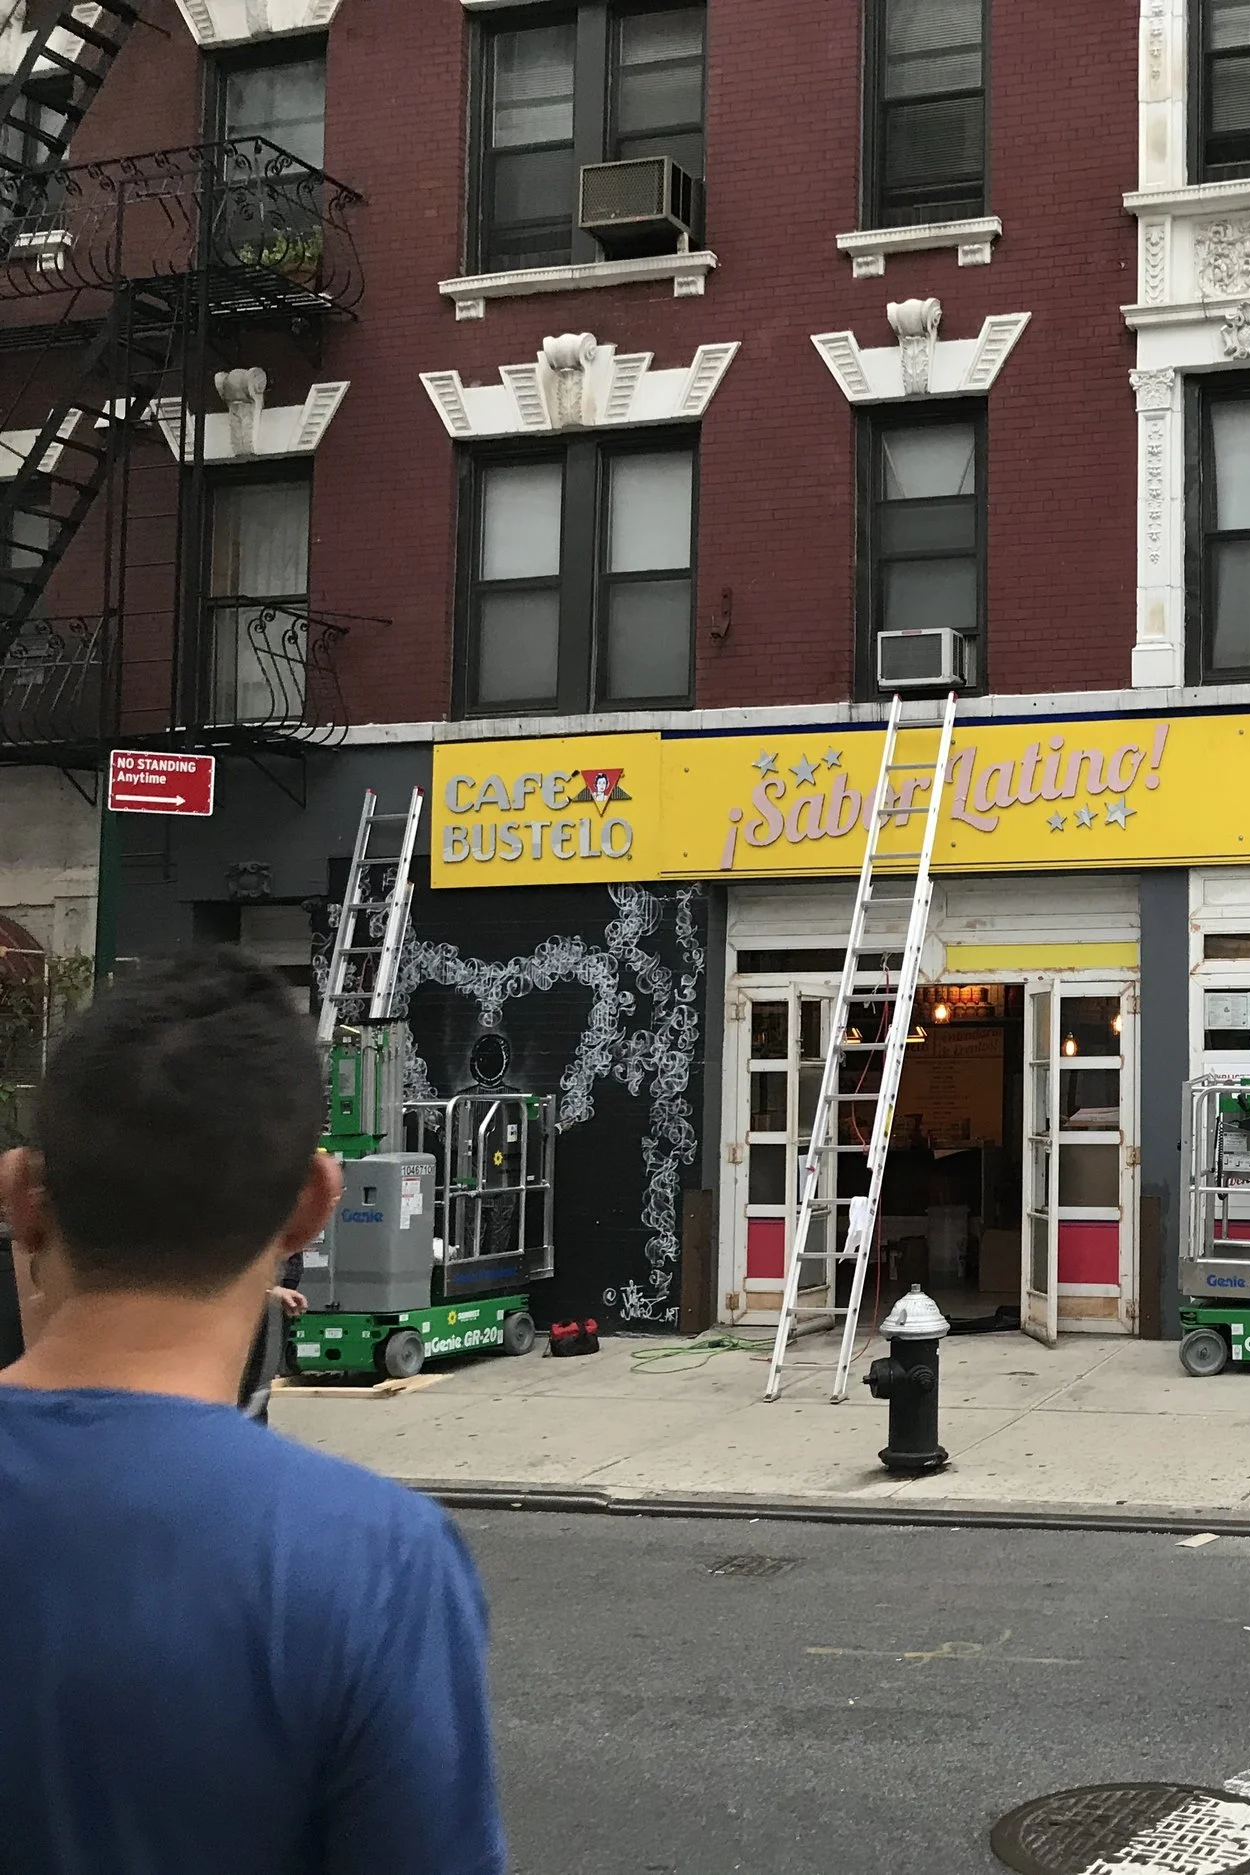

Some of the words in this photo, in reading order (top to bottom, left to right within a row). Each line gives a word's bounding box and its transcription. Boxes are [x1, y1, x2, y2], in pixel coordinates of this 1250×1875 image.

[117, 757, 134, 769] NO
[138, 759, 196, 773] STANDING
[117, 771, 166, 785] Anytime
[944, 724, 1170, 833] Latino!
[443, 817, 633, 864] BUSTELO
[1206, 1275, 1246, 1288] Genie
[431, 1334, 462, 1353] Genie
[464, 1326, 498, 1347] GR-20
